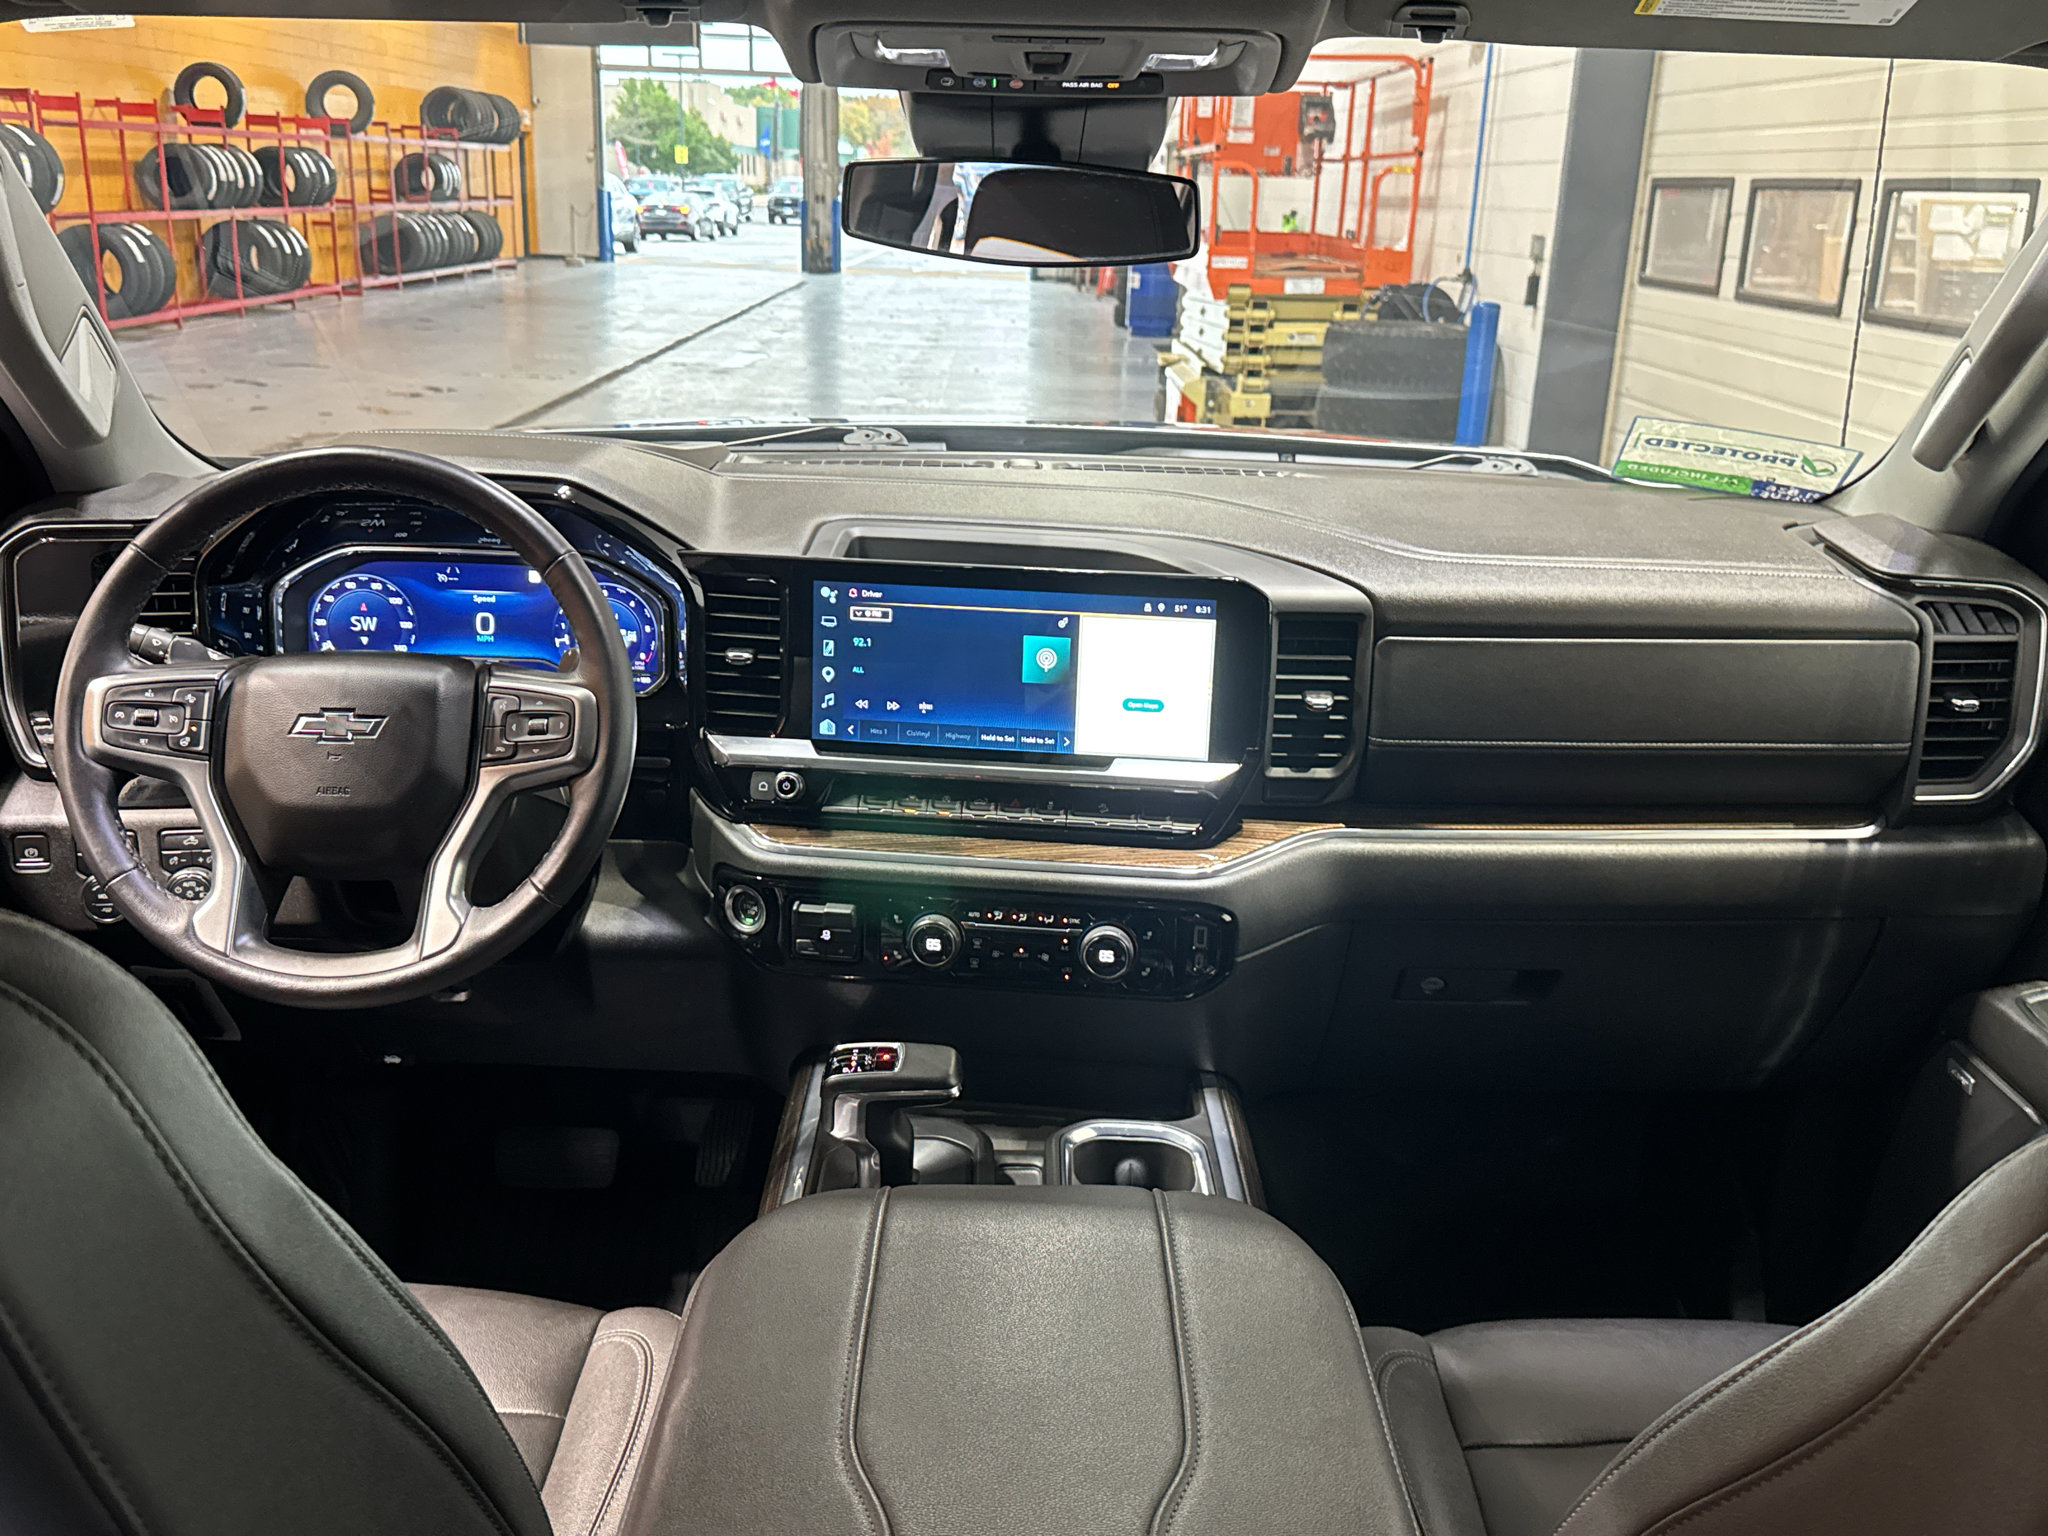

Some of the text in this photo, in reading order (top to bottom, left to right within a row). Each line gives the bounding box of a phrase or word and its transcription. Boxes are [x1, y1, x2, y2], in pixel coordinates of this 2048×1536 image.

[861, 589, 883, 598] Driver
[472, 594, 496, 604] Speed
[350, 616, 378, 632] SW
[475, 612, 495, 635] 0
[852, 637, 872, 648] 92.1
[852, 666, 865, 674] ALL
[945, 732, 971, 741] Highway
[981, 733, 996, 742] Hold
[1004, 735, 1015, 743] Set
[1021, 736, 1036, 744] Hold
[1044, 737, 1055, 745] Set
[315, 785, 351, 797] AIRBAG
